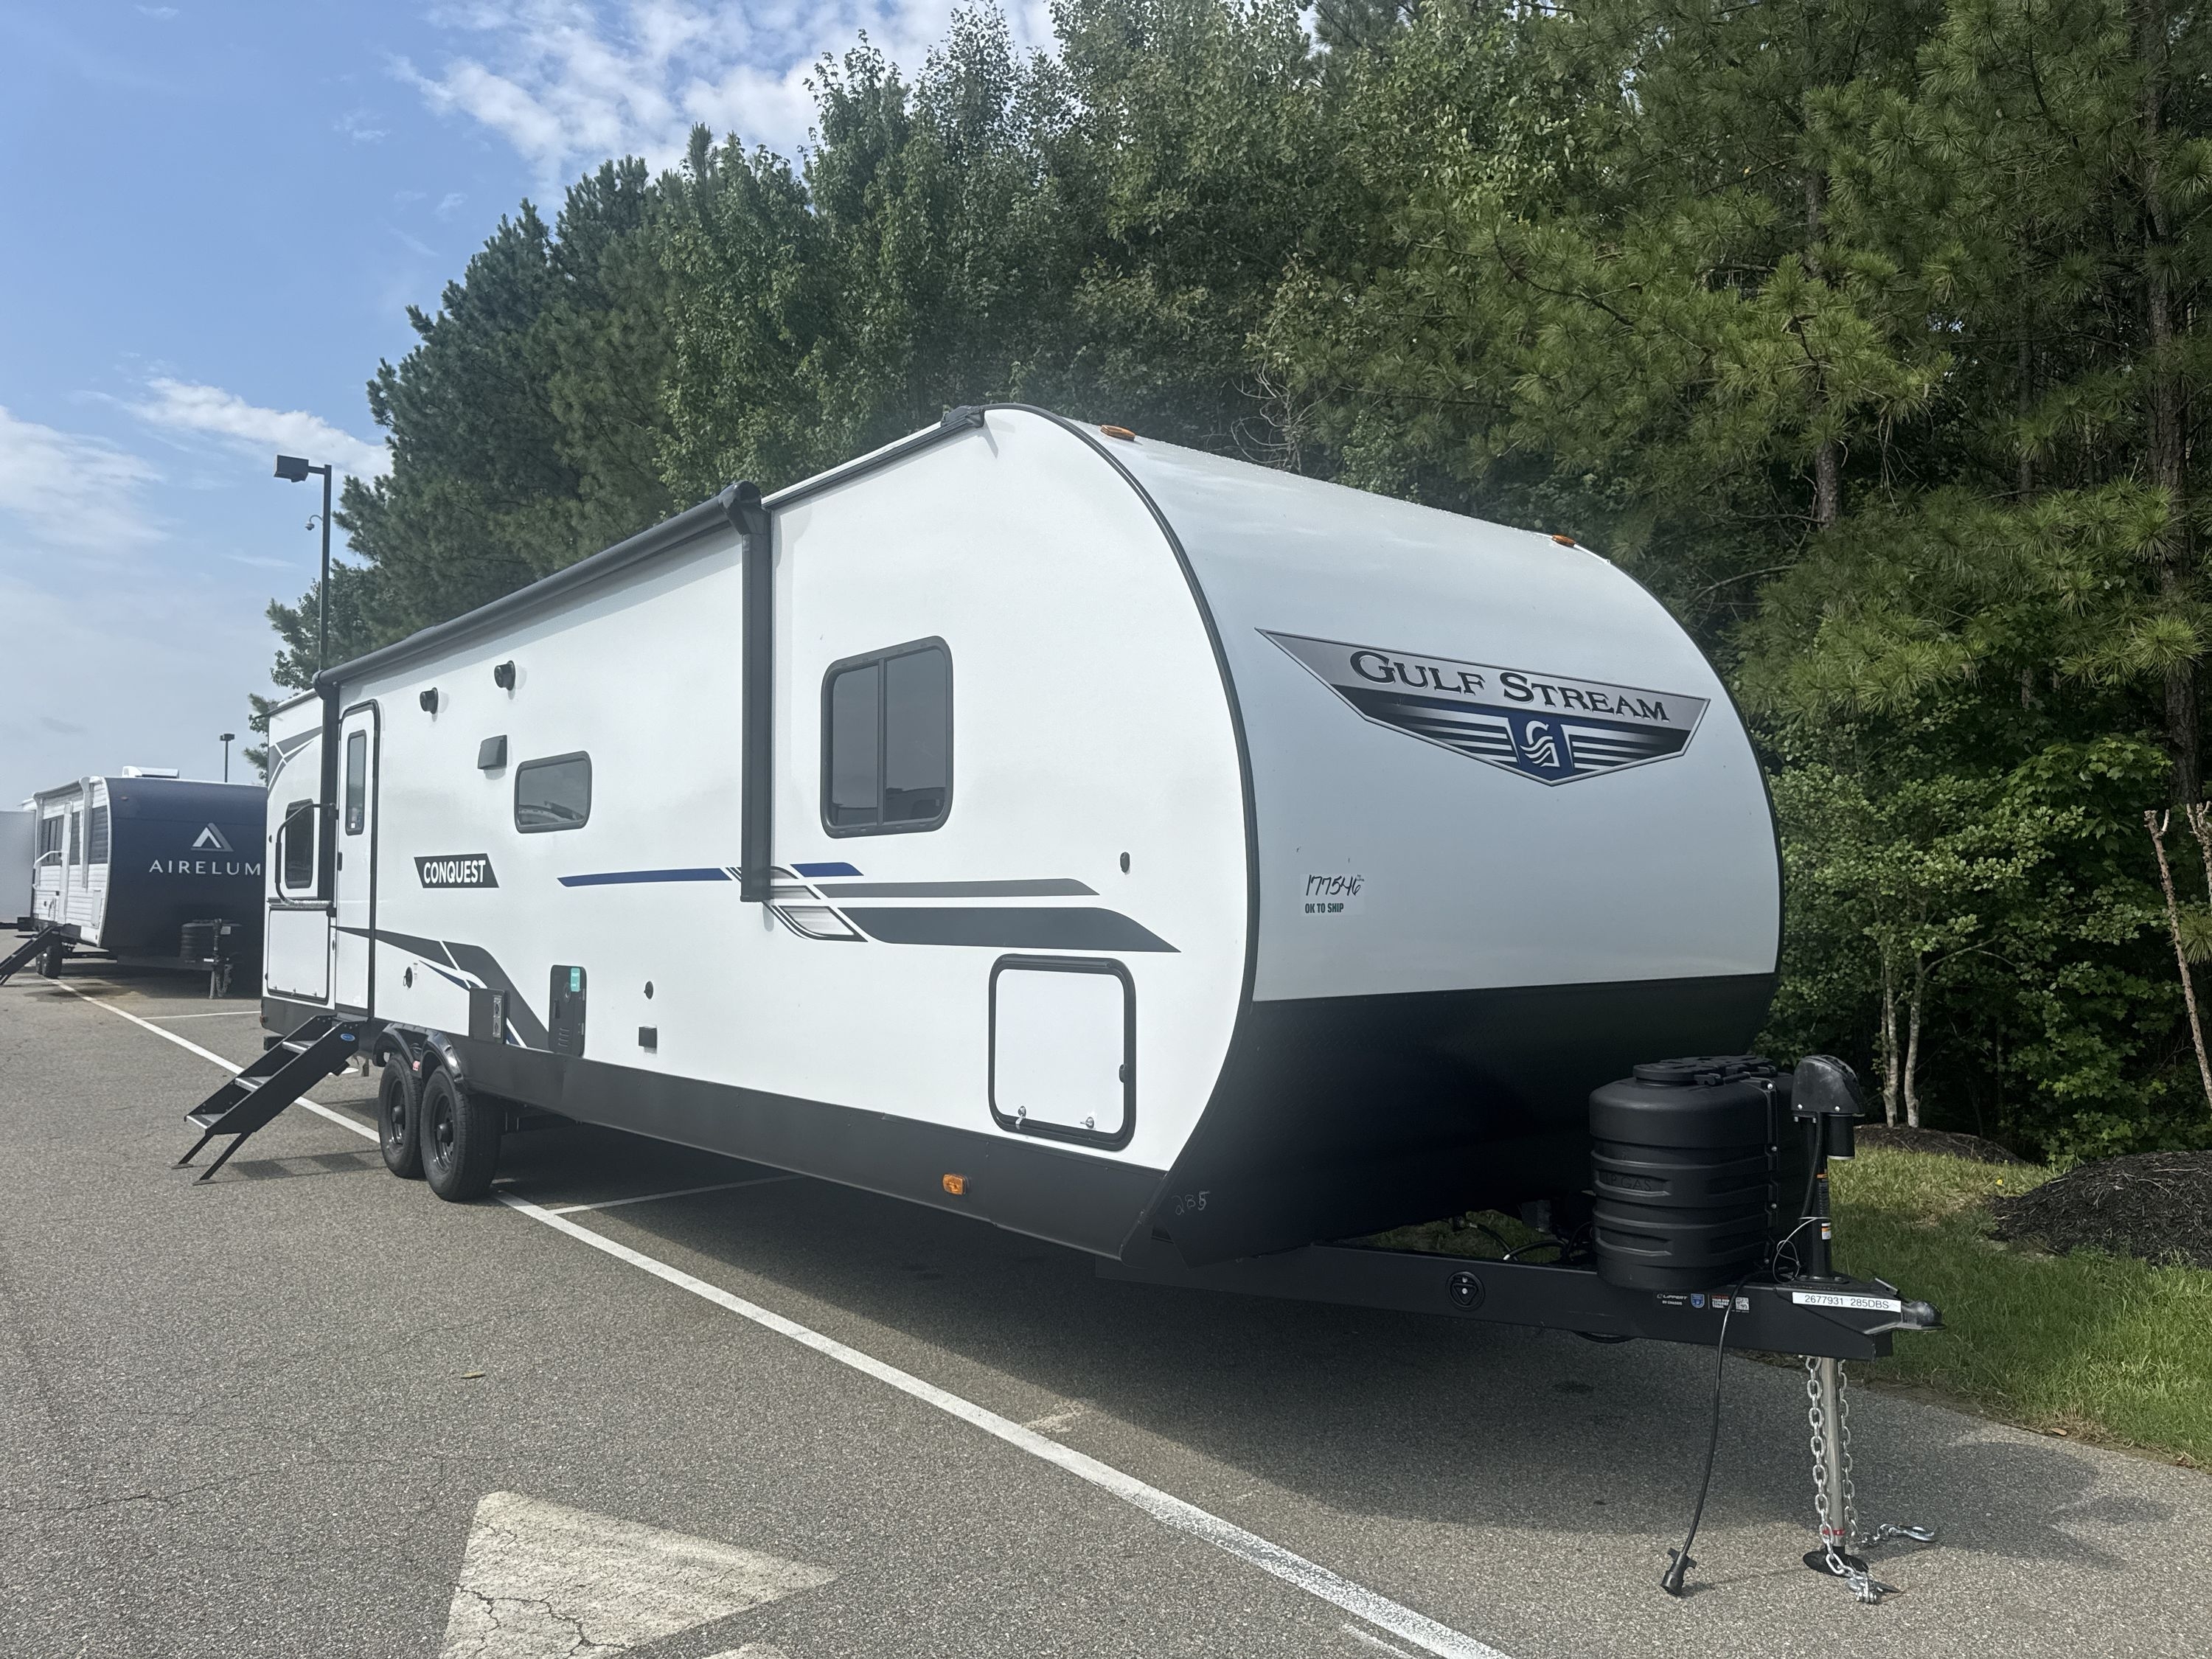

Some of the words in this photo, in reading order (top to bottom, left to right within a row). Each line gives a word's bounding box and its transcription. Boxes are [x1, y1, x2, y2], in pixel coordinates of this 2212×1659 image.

[1350, 650, 1485, 695] GULF
[1499, 672, 1671, 723] STREAM
[149, 860, 261, 875] AIRELUM
[423, 860, 486, 883] CONQUEST
[1306, 874, 1361, 896] 177546
[1304, 902, 1315, 914] OK
[1317, 902, 1326, 913] TO
[1327, 902, 1344, 913] SHIP
[1621, 1175, 1652, 1192] GAS
[1804, 1295, 1843, 1306] 2677931
[1850, 1298, 1889, 1310] 285DBS
